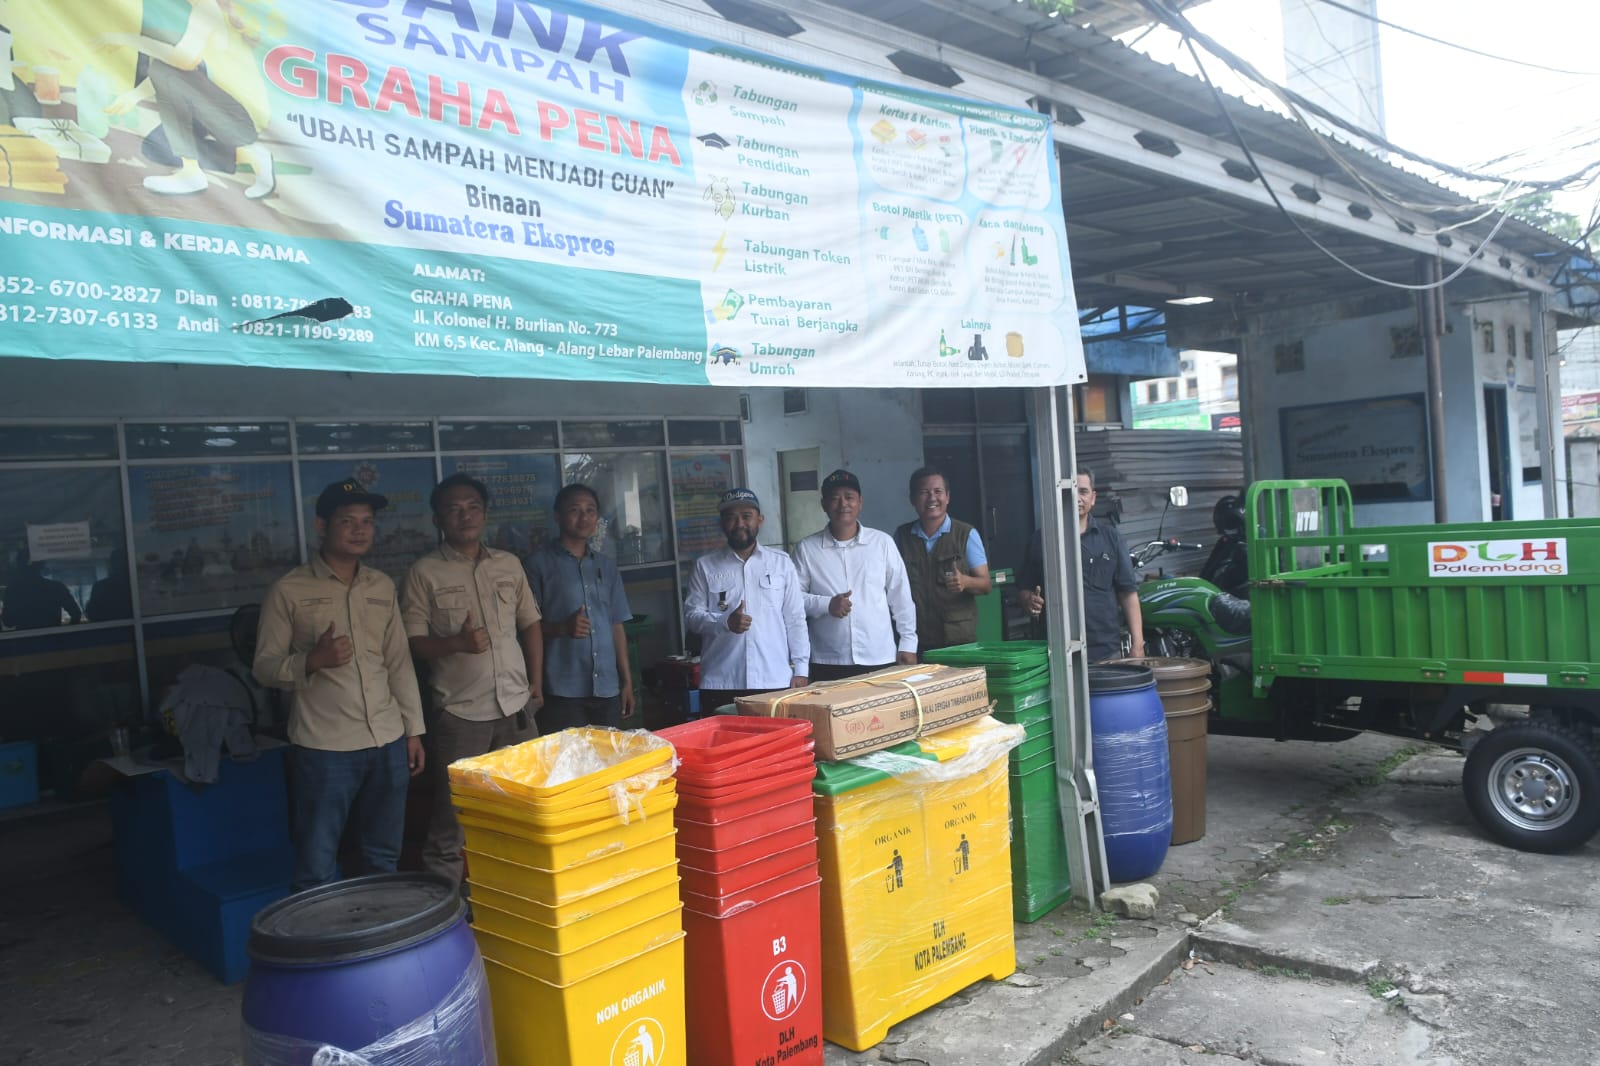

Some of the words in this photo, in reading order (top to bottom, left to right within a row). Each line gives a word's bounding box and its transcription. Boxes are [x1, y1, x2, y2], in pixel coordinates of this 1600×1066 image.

[338, 0, 644, 77] ANK
[356, 12, 625, 102] SAMPAH
[263, 45, 521, 136] GRAHA
[537, 99, 682, 167] PENA
[732, 84, 798, 113] Tabungan
[729, 105, 786, 127] Sampah
[879, 103, 910, 121] Kertas
[911, 111, 917, 122] &
[735, 134, 800, 159] Tabungan
[384, 133, 495, 173] SAMPAH
[504, 155, 604, 190] MENJADI
[737, 153, 810, 177] Pendidikan
[465, 183, 541, 218] Binaan
[741, 181, 809, 205] Tabungan
[741, 202, 790, 222] Kurban
[872, 202, 900, 216] Botol
[902, 205, 933, 221] Plastik
[383, 199, 515, 244] Sumatera
[523, 220, 615, 257] Ekspres
[139, 230, 156, 248] &
[164, 232, 241, 257] KERJA
[245, 241, 310, 265] SAMA
[743, 239, 810, 261] Tabungan
[813, 248, 851, 265] Token
[412, 263, 486, 283] ALAMAT:
[744, 259, 787, 276] Listrik
[49, 279, 162, 304] 6700-2827
[175, 289, 218, 308] Dian
[410, 288, 469, 308] GRAHA
[473, 293, 513, 311] PENA
[748, 293, 832, 312] Pembayaran
[177, 316, 219, 334] Andi
[412, 310, 430, 325] Jl.
[433, 310, 491, 330] Kolonel
[495, 315, 511, 331] H.
[515, 317, 564, 334] Burlian
[568, 320, 591, 336] No.
[594, 322, 618, 337] 773
[750, 313, 790, 327] Tunai
[797, 316, 859, 334] Berjangka
[960, 319, 992, 331] Lainnya
[414, 332, 440, 348] KM
[444, 334, 467, 351] 6,5
[469, 335, 500, 352] Kec.
[503, 338, 545, 357] Alang
[555, 340, 595, 360] Alang
[598, 342, 635, 359] Lebar
[637, 346, 703, 364] Palembang
[751, 342, 816, 360] Tabungan
[749, 361, 796, 376] Umroh
[1433, 541, 1560, 563] DLH
[1433, 563, 1562, 575] Palembang
[952, 801, 968, 812] NON
[944, 811, 977, 830] ORGANIK
[874, 826, 912, 846] ORGANIK
[932, 919, 946, 940] DLH
[772, 935, 787, 957] B3
[913, 948, 931, 971] KOTA
[931, 932, 967, 964] PALEMBANG
[596, 1001, 619, 1025] NON
[621, 978, 667, 1012] ORGANIK
[778, 1026, 795, 1046] DLH
[755, 1056, 775, 1066] Kota
[777, 1034, 818, 1064] Palembang
